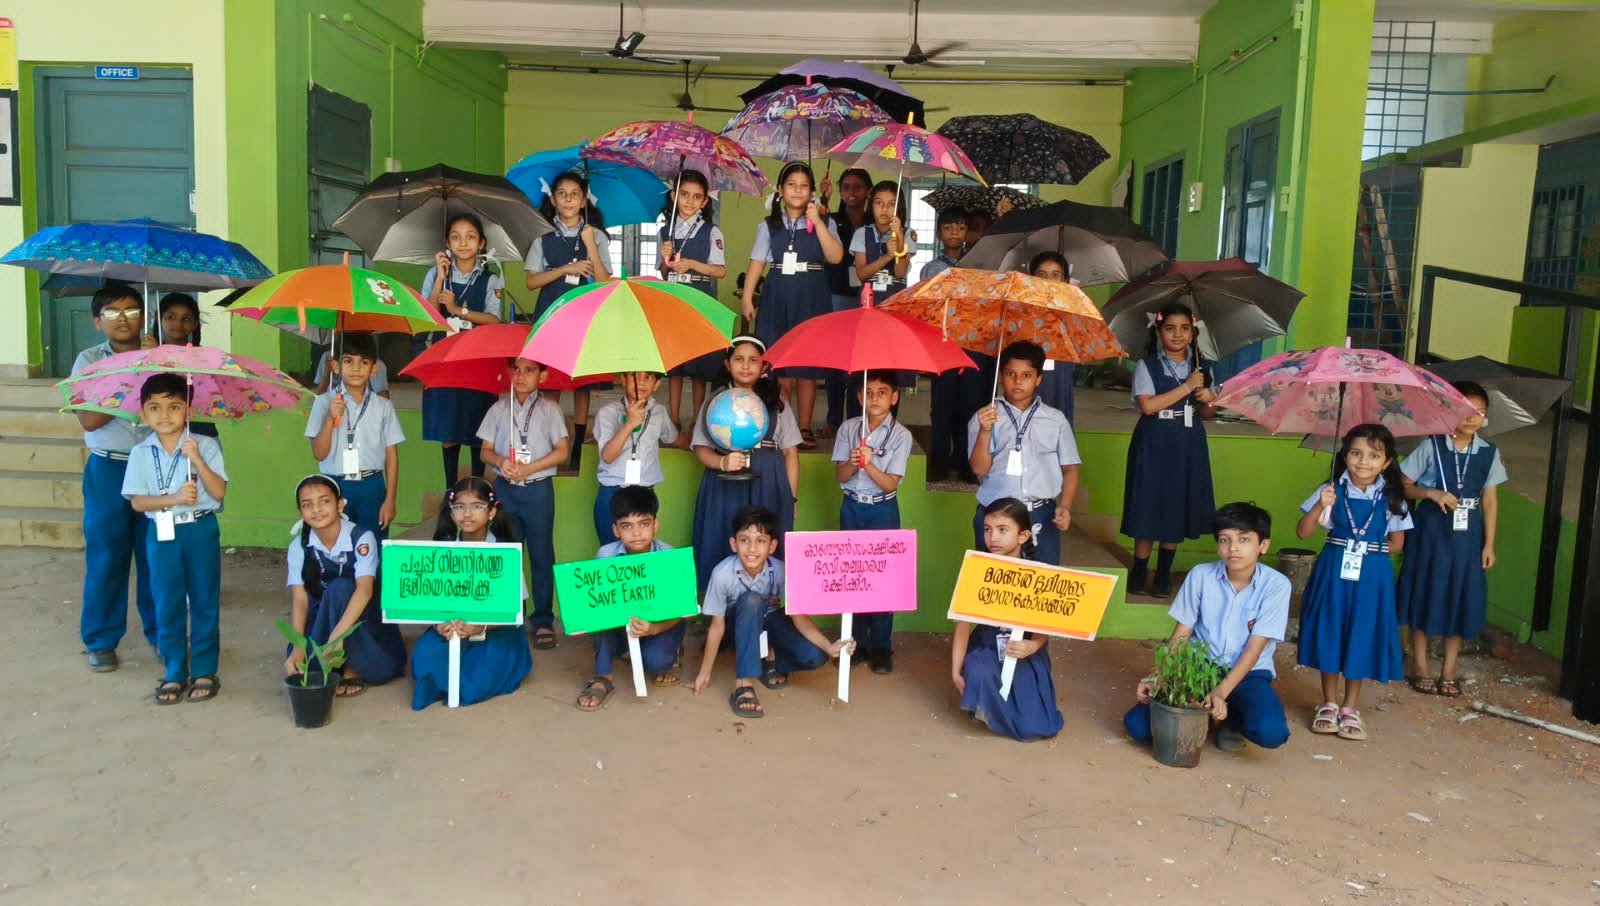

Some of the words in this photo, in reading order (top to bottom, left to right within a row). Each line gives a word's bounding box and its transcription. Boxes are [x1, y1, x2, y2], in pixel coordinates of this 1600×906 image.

[101, 67, 134, 77] OFFICE
[573, 567, 602, 589] SAVE
[606, 563, 647, 584] OZONE
[984, 566, 1037, 589] മരങ്ങൾ
[1033, 573, 1087, 598] ഭൂമിയുടെ
[588, 586, 617, 609] SAVE
[621, 582, 656, 603] EARTH
